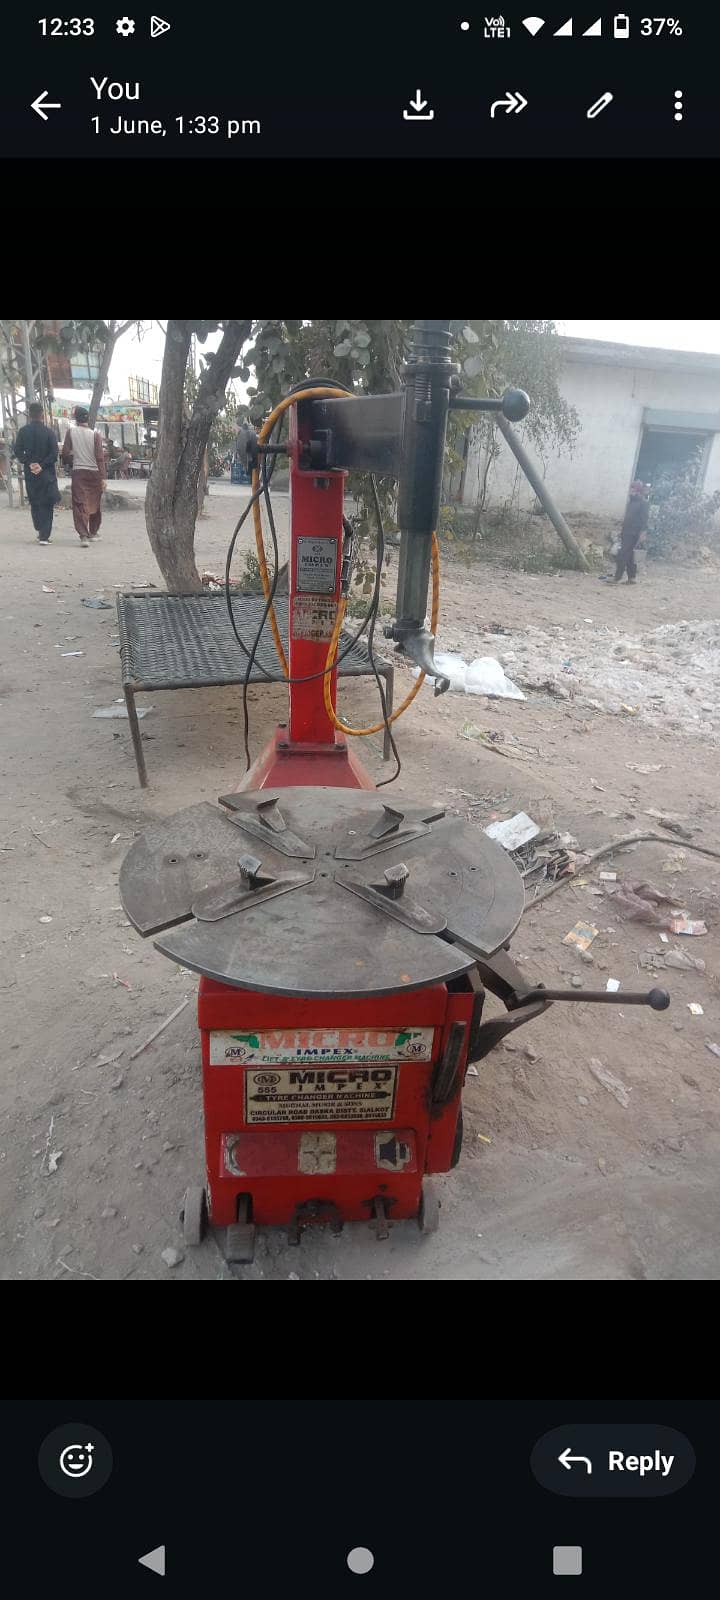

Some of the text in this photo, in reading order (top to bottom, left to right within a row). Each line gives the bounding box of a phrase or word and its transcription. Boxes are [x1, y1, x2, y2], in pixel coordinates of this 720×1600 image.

[302, 555, 333, 564] MICRO
[260, 1031, 395, 1049] MICRO
[289, 1069, 392, 1085] MICRO
[336, 1092, 376, 1100] MACHINE
